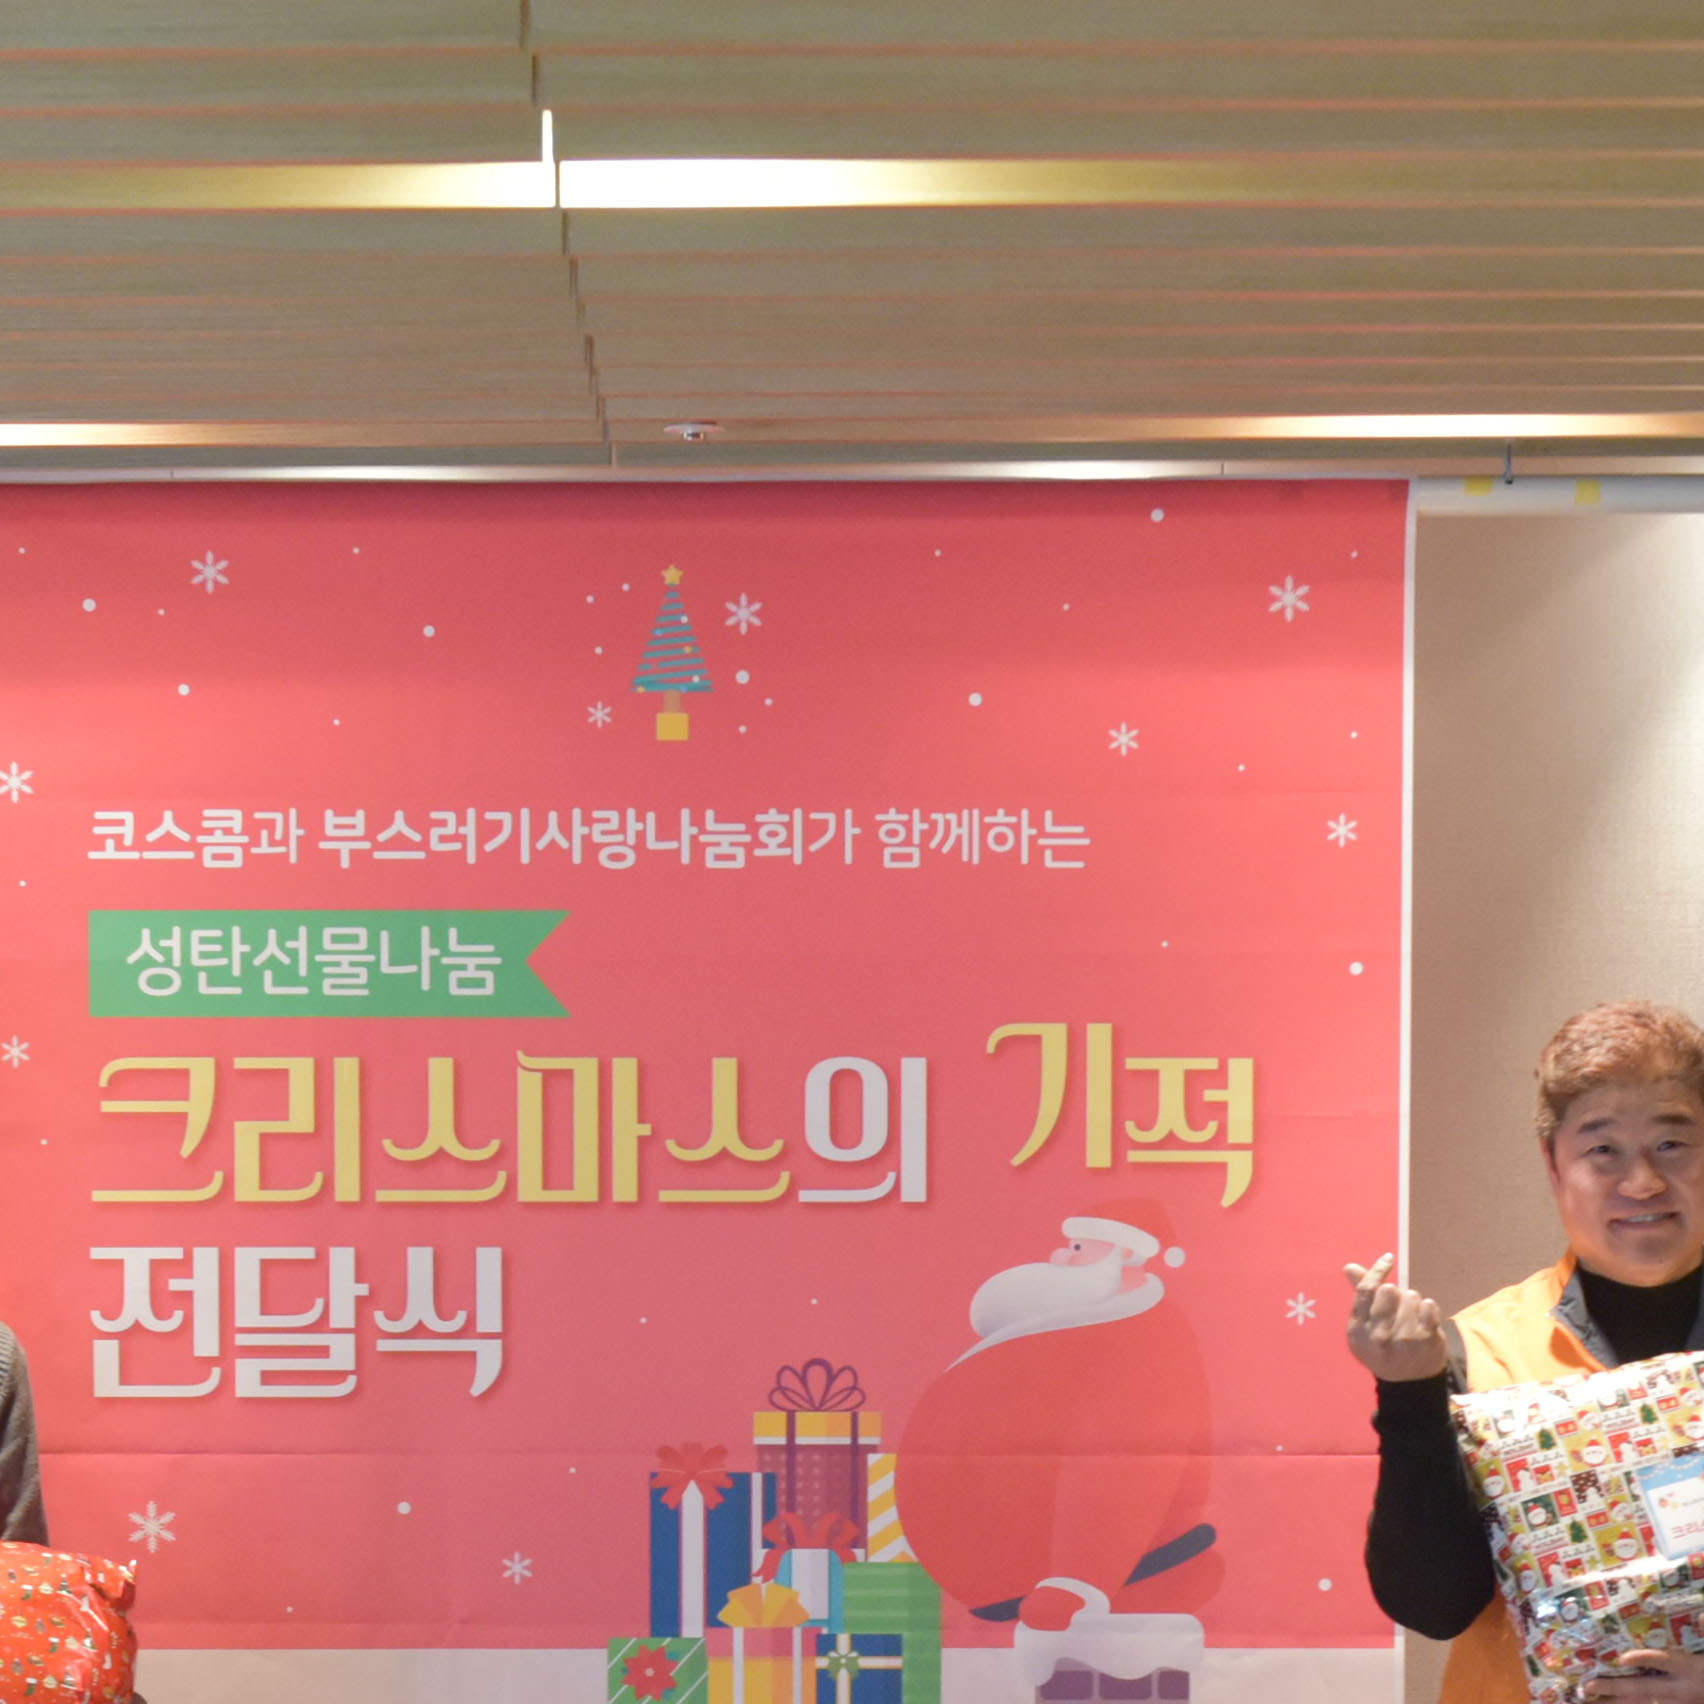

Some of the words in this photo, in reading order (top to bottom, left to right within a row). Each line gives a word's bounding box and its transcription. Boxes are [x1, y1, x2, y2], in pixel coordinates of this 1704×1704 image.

[87, 808, 304, 868] 코스콤과
[317, 808, 862, 870] 부스러기사랑나눔회가
[873, 808, 1093, 871] 함께하는
[124, 924, 504, 999] 성탄선물나눔
[89, 1049, 929, 1204] 크리스마스의
[983, 1020, 1257, 1210] 기적
[88, 1244, 505, 1400] 전달식
